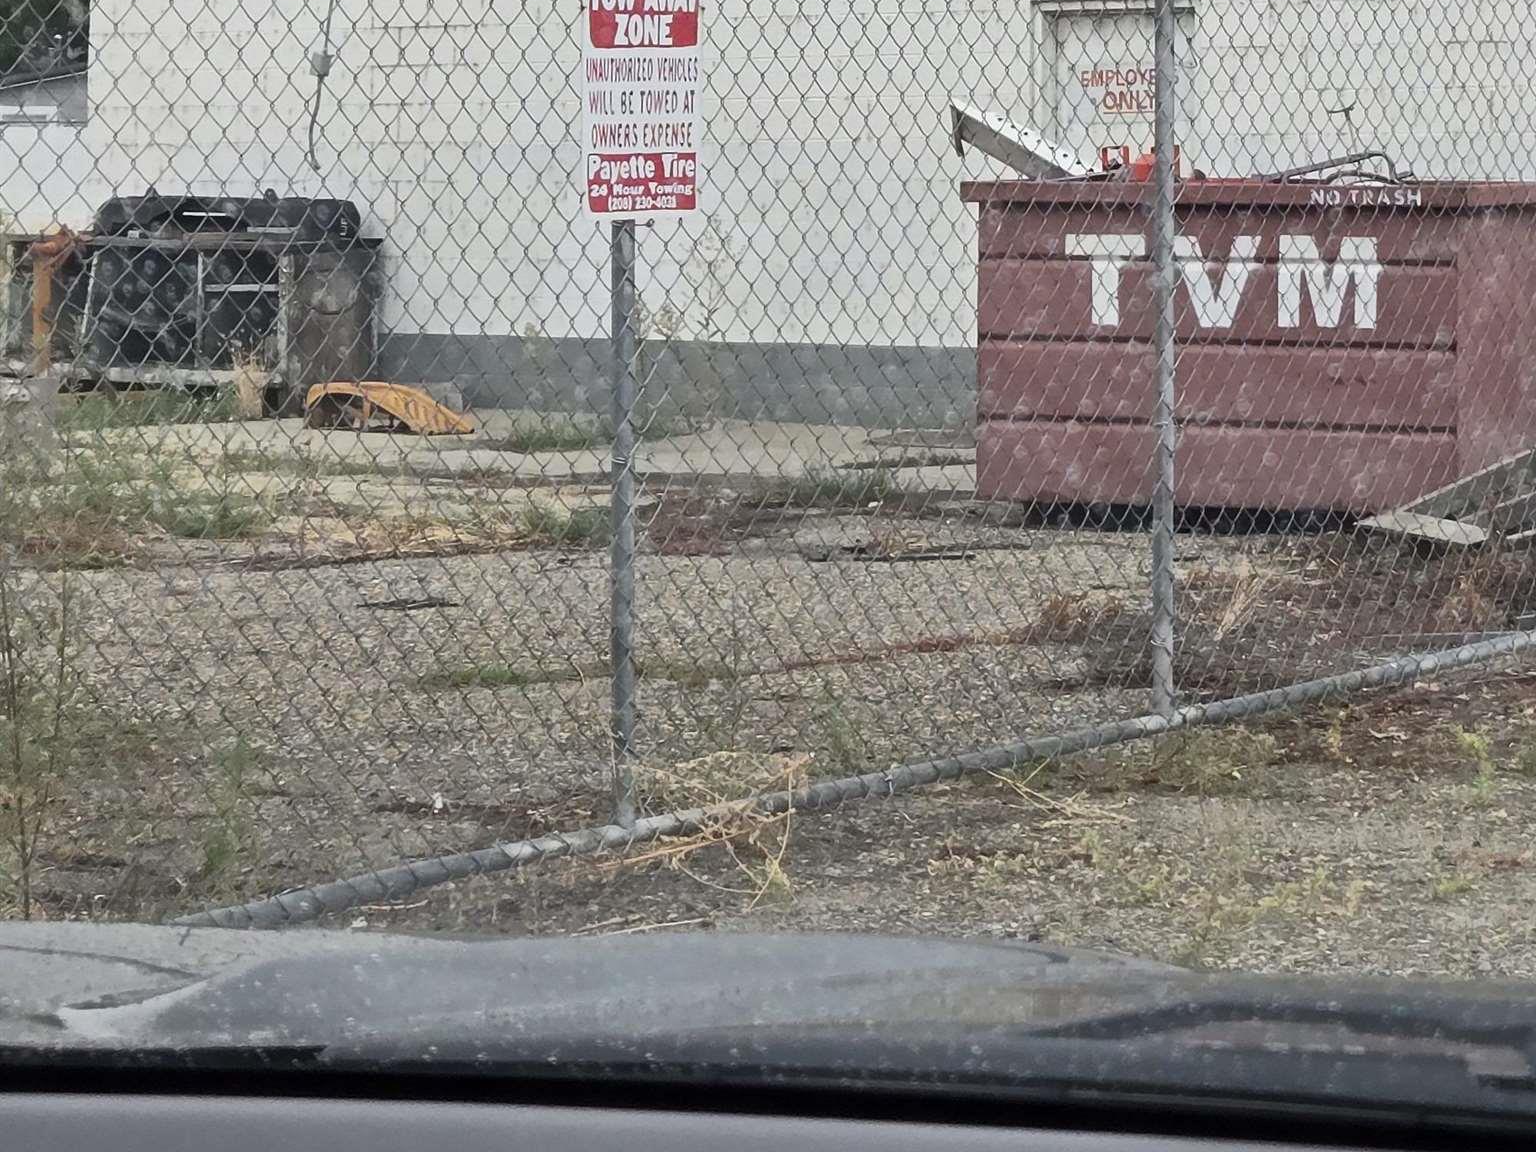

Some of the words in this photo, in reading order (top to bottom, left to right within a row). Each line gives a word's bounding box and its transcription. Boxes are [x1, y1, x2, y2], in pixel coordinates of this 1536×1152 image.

[614, 13, 673, 46] ZONE
[586, 57, 653, 83] UNAUTHORIZED
[656, 56, 698, 82] VEHICLES
[589, 90, 615, 115] WILL
[620, 90, 634, 115] BE
[640, 89, 678, 115] TOWED
[682, 89, 696, 114] AT
[1103, 90, 1155, 110] ONLY
[592, 123, 638, 148] OWNERS
[643, 122, 693, 147] EXPENSE
[588, 155, 656, 184] Payette
[661, 153, 695, 178] Tire
[648, 182, 694, 195] Towing
[1310, 188, 1340, 205] NO
[1350, 189, 1421, 206] TRASH
[1065, 234, 1379, 330] TVM
